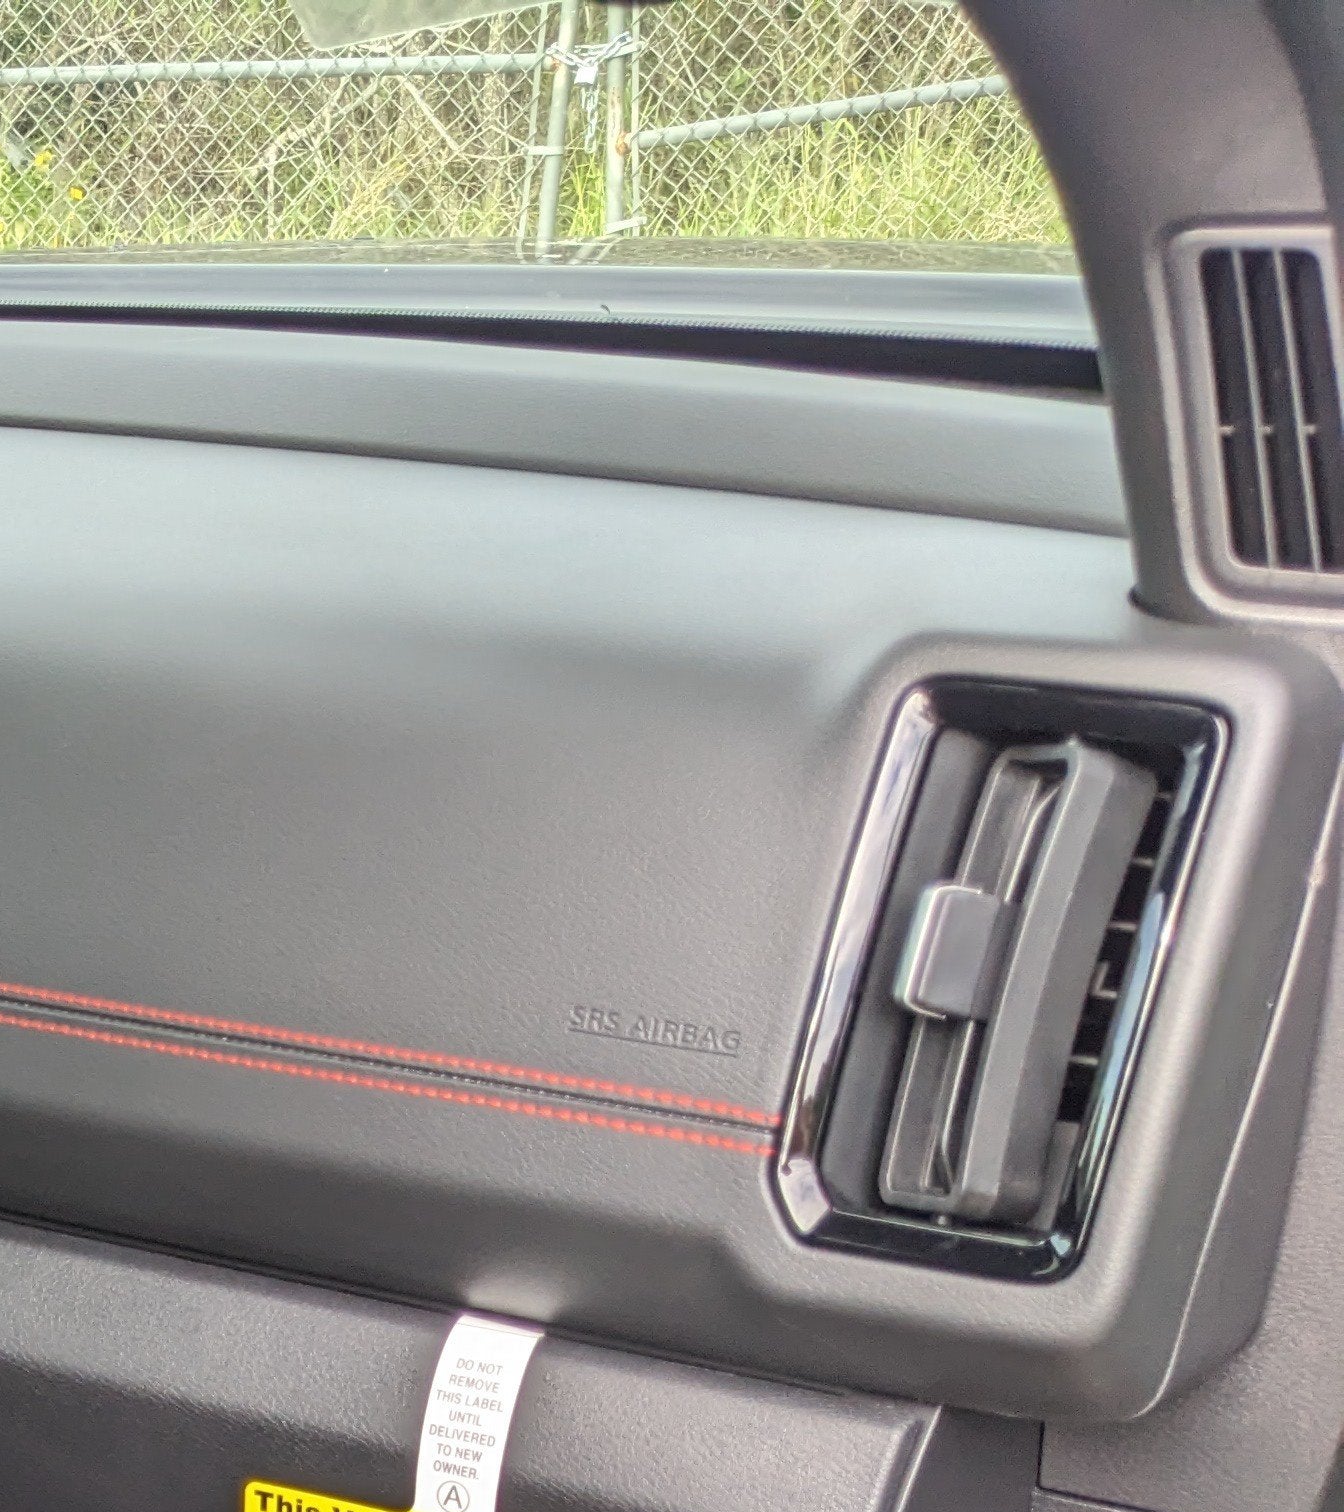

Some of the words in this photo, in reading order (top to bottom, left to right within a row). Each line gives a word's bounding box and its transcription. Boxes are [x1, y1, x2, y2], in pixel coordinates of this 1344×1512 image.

[568, 1005, 620, 1032] SRS
[629, 1014, 742, 1050] AIRBAG
[456, 1358, 474, 1371] DO
[477, 1361, 503, 1376] NOT
[449, 1374, 500, 1393] REMOVE
[436, 1389, 462, 1405] THIS
[465, 1395, 503, 1412] LABEL
[448, 1410, 482, 1426] UNTIL
[429, 1423, 496, 1447] DELIVERED
[437, 1442, 452, 1456] TO
[455, 1447, 483, 1462] NEW
[433, 1460, 479, 1480] OWNER.
[443, 1485, 462, 1509] A
